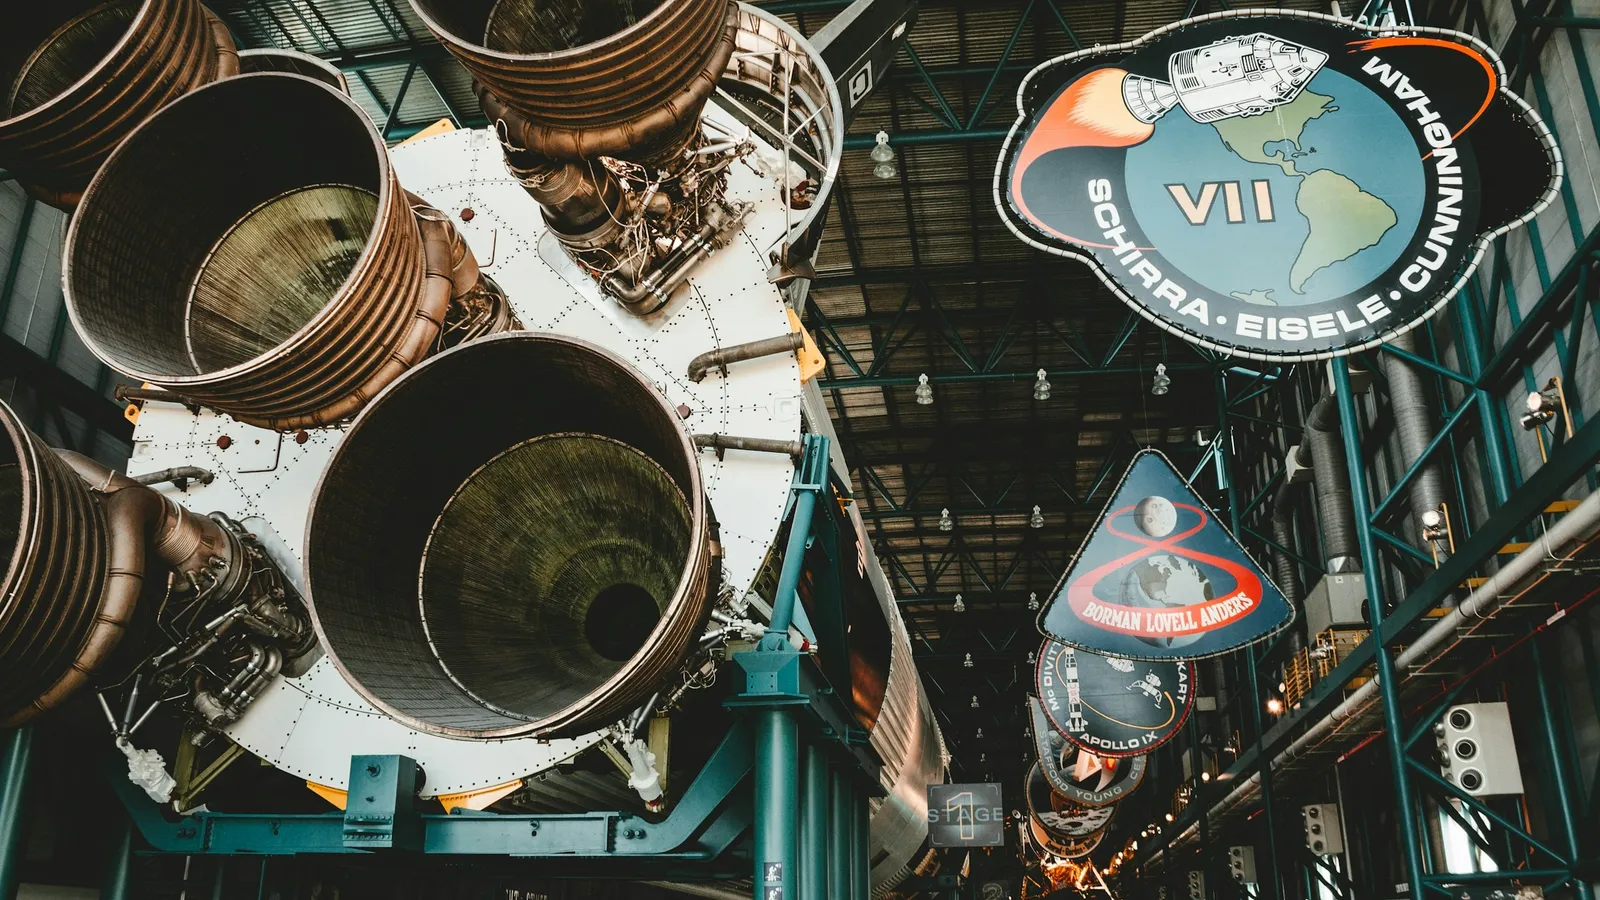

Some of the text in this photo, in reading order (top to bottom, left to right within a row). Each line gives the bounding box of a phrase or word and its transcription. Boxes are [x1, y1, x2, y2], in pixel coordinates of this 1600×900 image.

[1087, 56, 1464, 342] SCHIRRA EISELE CUNNINGHAM
[1165, 179, 1276, 226] VII
[1082, 591, 1254, 633] BORMAN LOVELL ANDERS
[1080, 731, 1159, 750] APOLLO IX
[1040, 730, 1069, 792] STAFFORD
[1075, 786, 1123, 802] YOUNG
[927, 807, 1004, 823] STAGE
[946, 792, 975, 840] 1
